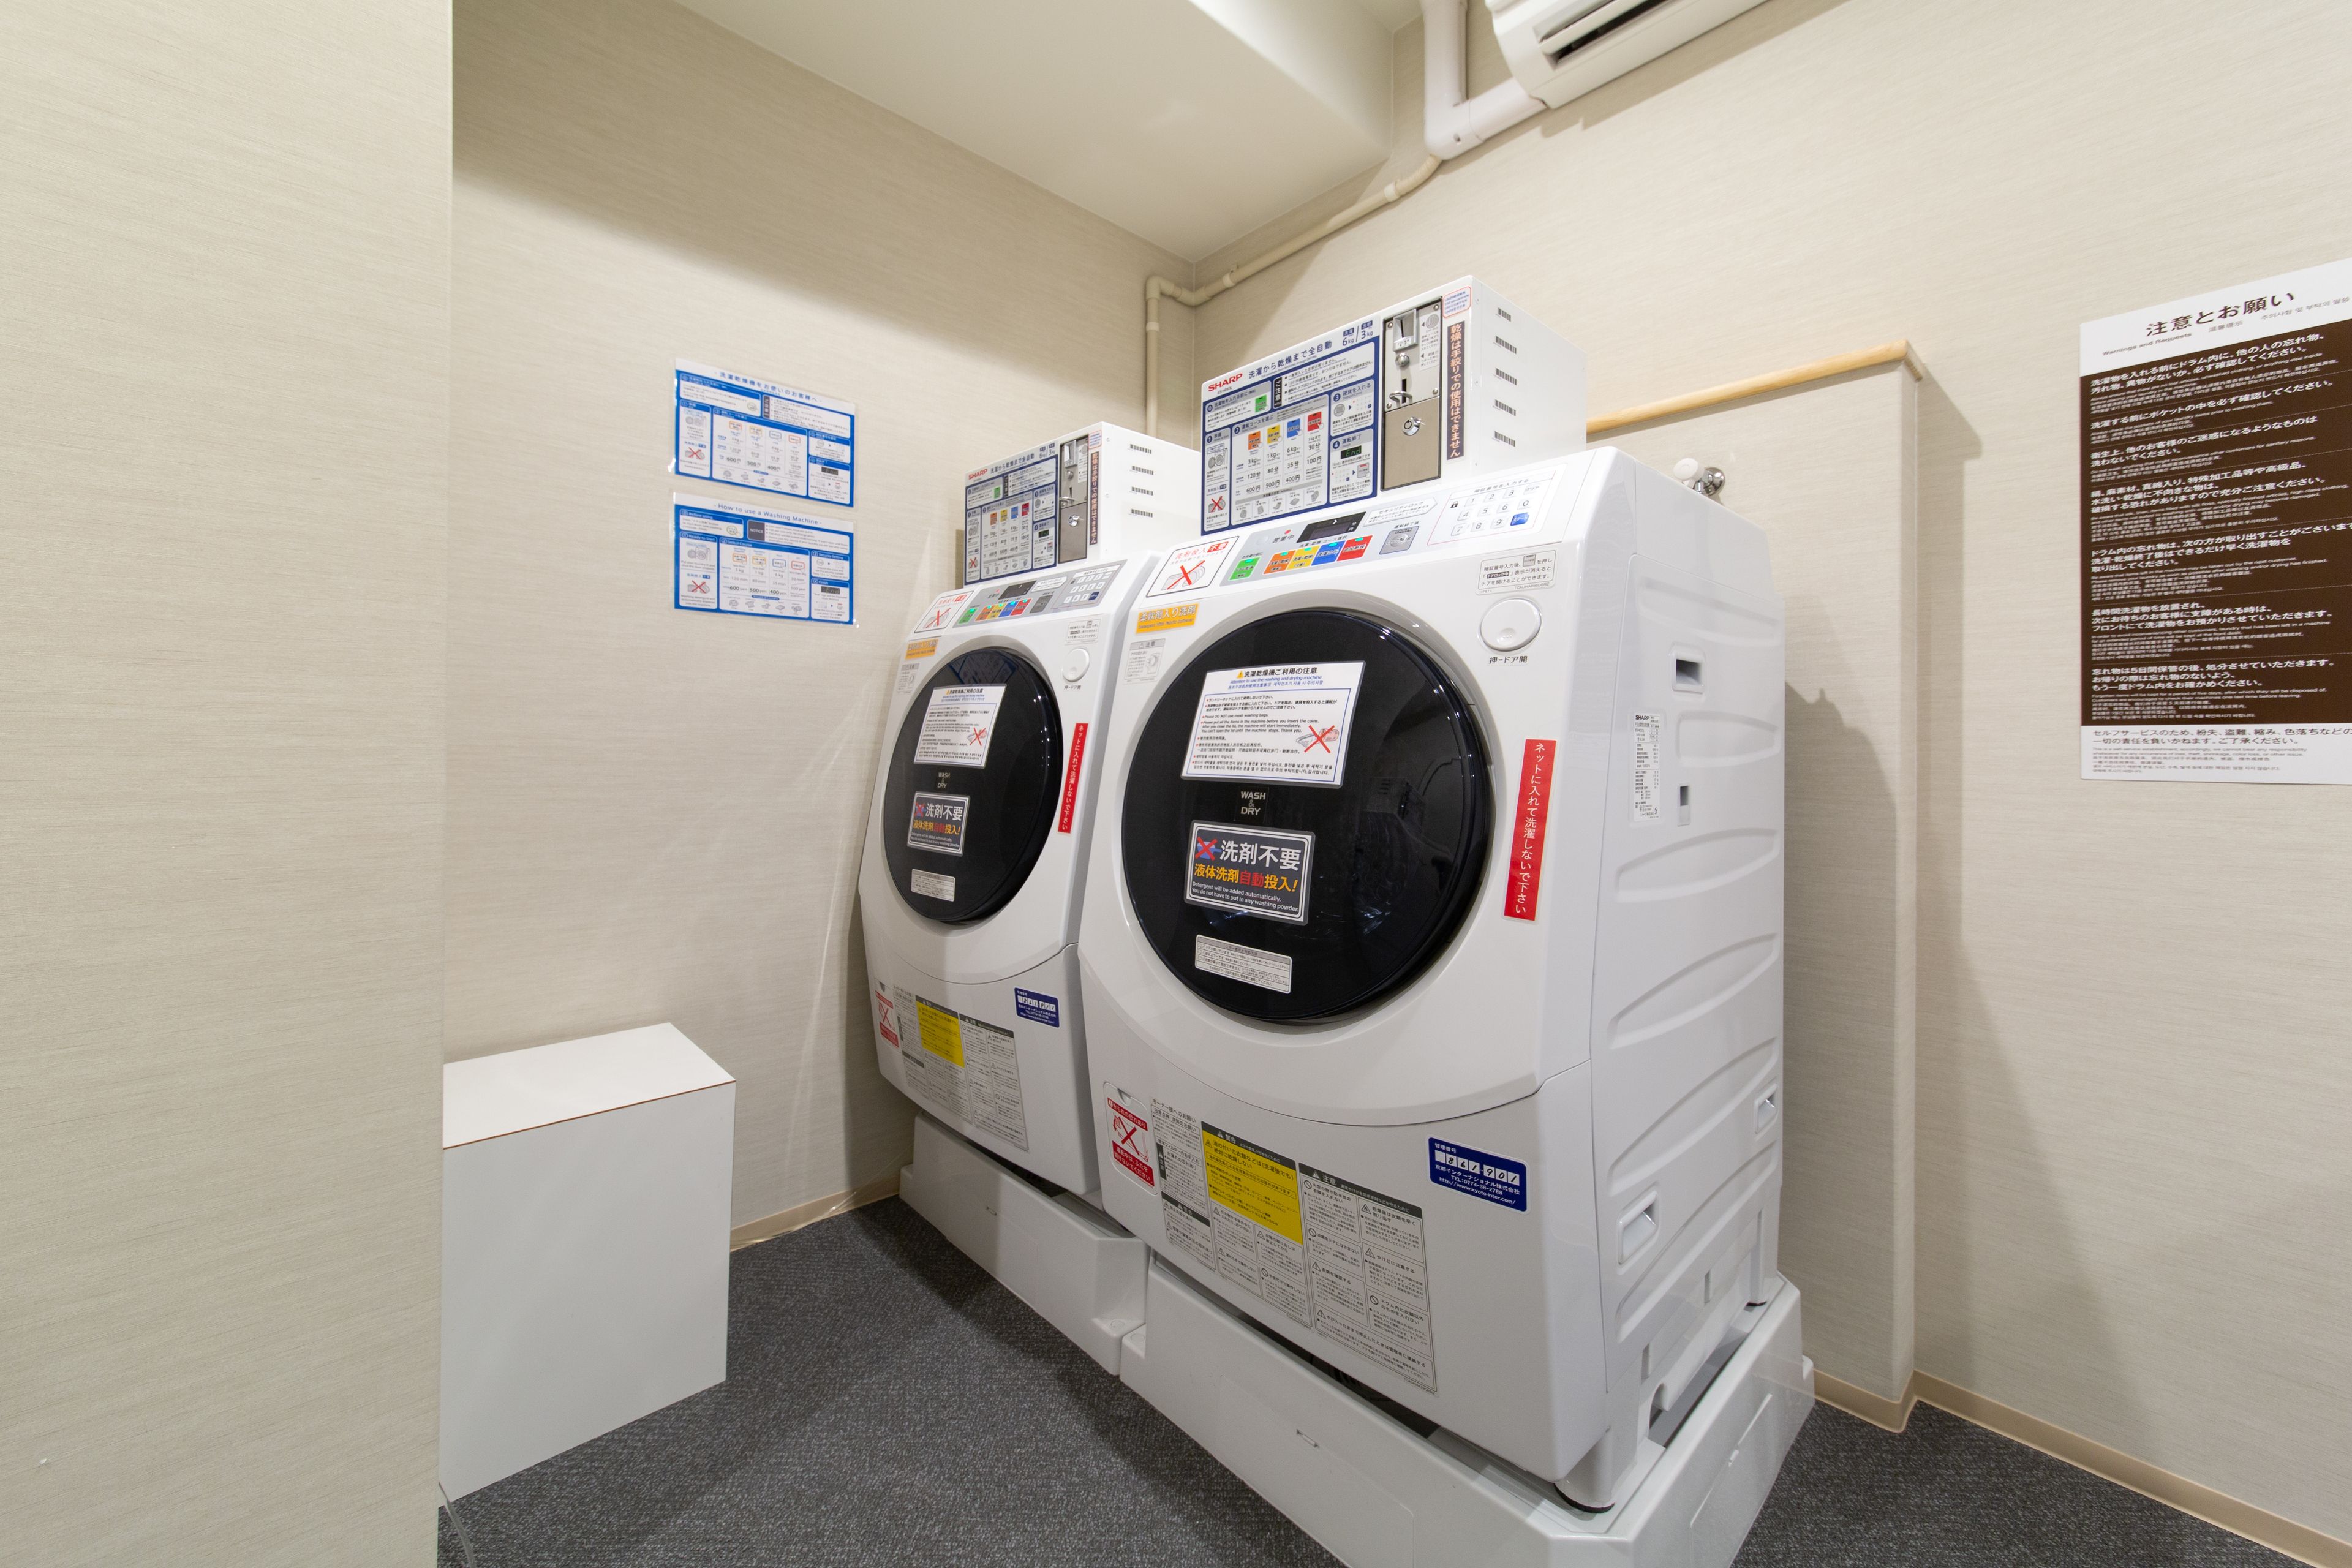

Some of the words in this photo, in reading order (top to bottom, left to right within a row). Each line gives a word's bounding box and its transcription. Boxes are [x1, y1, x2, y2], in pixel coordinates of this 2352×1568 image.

[2146, 289, 2294, 337] 注意とお願い
[2102, 343, 2137, 356] Warnings
[2155, 331, 2192, 345] Requests
[1248, 339, 1332, 380] 洗濯から乾燥まで全自動
[720, 371, 818, 402] 洗濯乾燥機をお使いのお客様へ
[1208, 372, 1242, 393] SHARP
[1343, 382, 1371, 397] 硬貨を入れる
[1450, 325, 1462, 458] 乾燥は手絞りでの使用はできません
[1342, 434, 1361, 444] 運転終了
[1346, 446, 1360, 458] End
[2091, 447, 2180, 467] 洗わないでください。
[968, 469, 987, 480] SHARP
[764, 511, 790, 521] Washing
[793, 516, 818, 524] Machine
[1272, 535, 1294, 543] 営業中
[1484, 562, 1521, 571] 暗証番号入力後、
[2091, 557, 2179, 573] 取り出してください。
[1482, 575, 1549, 586] ドアを開けることができます。
[1140, 605, 1196, 622] 柔軟剤入り洗剤
[2092, 609, 2332, 632] フロントにて洗濯物をお預かりさせていただきます。
[1244, 666, 1318, 677] 洗濯乾燥機ご利用の注意
[2092, 658, 2334, 675] 忘れ物は5日間保管の後、処分させていただきます。
[2092, 679, 2262, 691] もう一度ドラム内をお確かめください。
[2093, 728, 2352, 736] セルフサービスのため、紛失、盗難、縮み、色落ちなどの
[1240, 791, 1265, 800] WASH
[925, 804, 963, 821] 洗剤不要
[1515, 743, 1545, 914] ネットに入れて洗濯しないで下さい
[1220, 840, 1302, 870] 洗剤不要
[1193, 881, 1213, 890] Detergent
[1245, 892, 1281, 902] automatically.
[1254, 900, 1276, 909] washing
[1277, 903, 1298, 912] powder.
[1153, 1099, 1196, 1123] オーナー様へのお願い
[1434, 1143, 1457, 1153] 管理番号
[1322, 1174, 1336, 1185] 注意
[1434, 1164, 1520, 1195] 京都インターナショナル株式会社
[1452, 1175, 1502, 1195] TEL:0774-38-2788
[1372, 1205, 1415, 1226] 乾燥後は衣類を早く
[1373, 1212, 1391, 1223] 取り出す
[1376, 1254, 1415, 1275] やけどに注意する
[1381, 1298, 1423, 1322] ドラム内に衣類以外
[1381, 1304, 1420, 1326] のものを入れない
